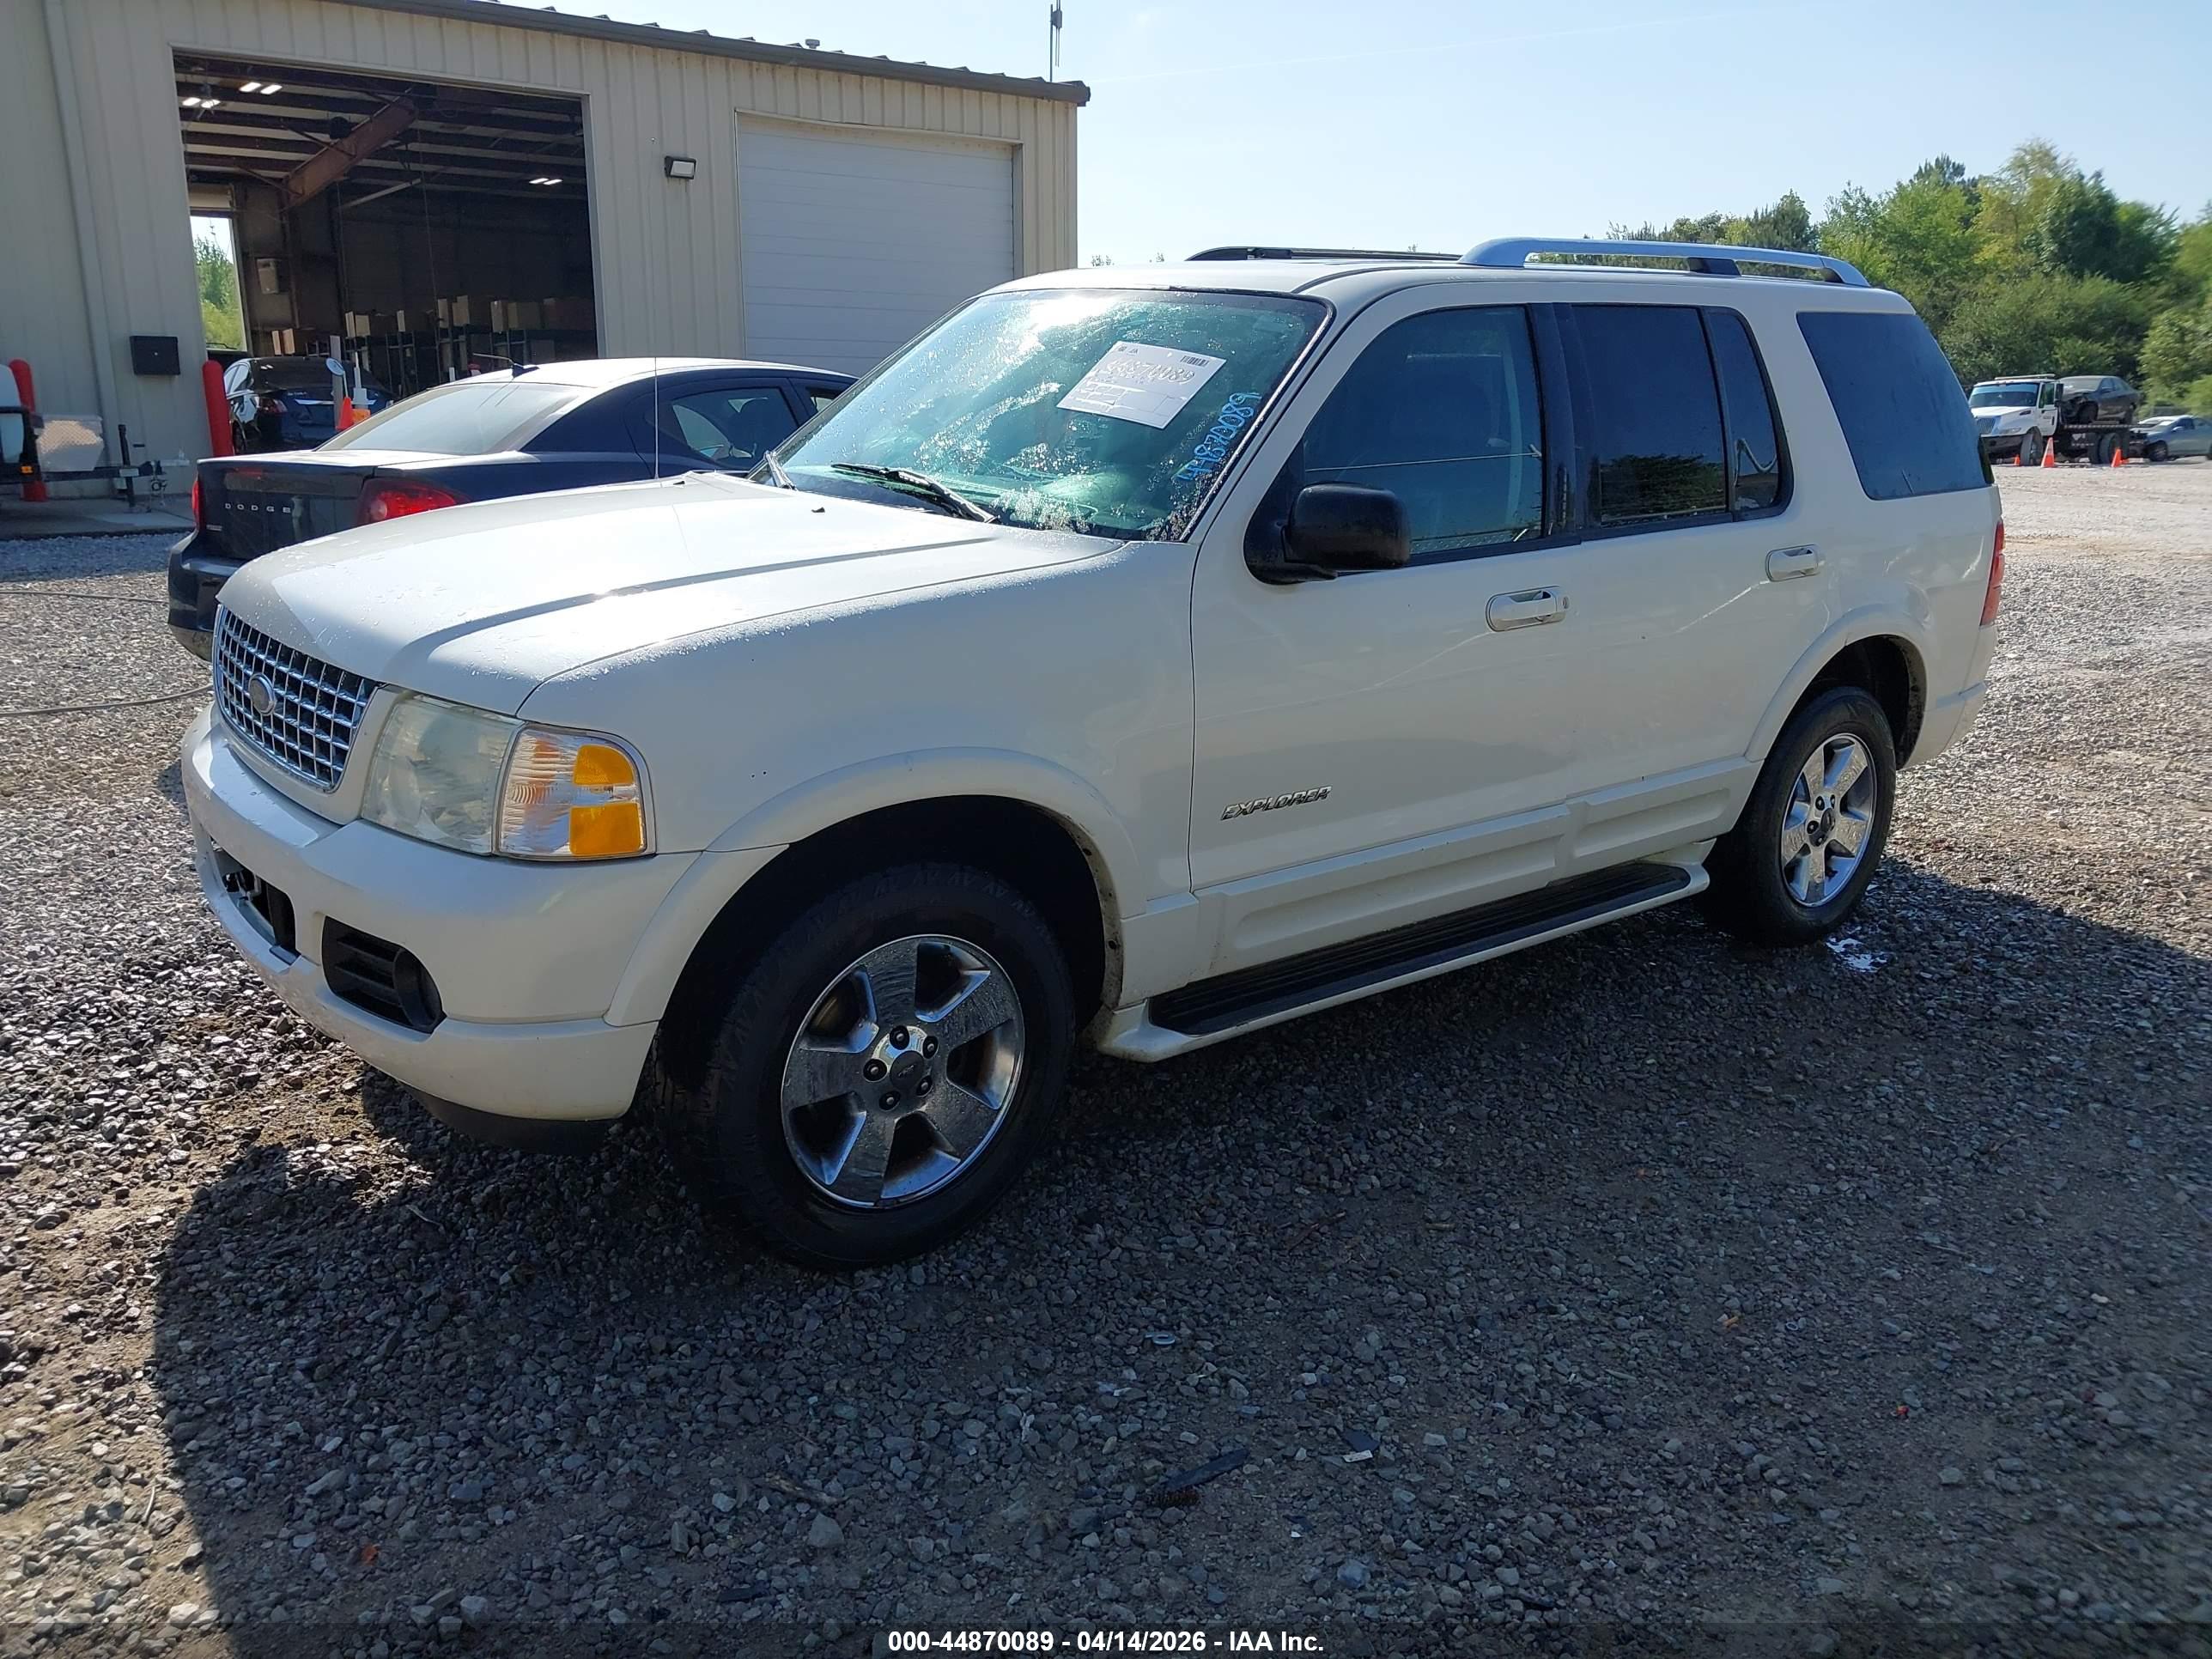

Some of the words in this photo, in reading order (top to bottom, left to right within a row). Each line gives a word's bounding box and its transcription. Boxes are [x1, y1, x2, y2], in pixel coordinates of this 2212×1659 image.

[1171, 392, 1263, 481] 44870089
[225, 502, 291, 514] DODGE
[1220, 785, 1333, 821] EXPLORER
